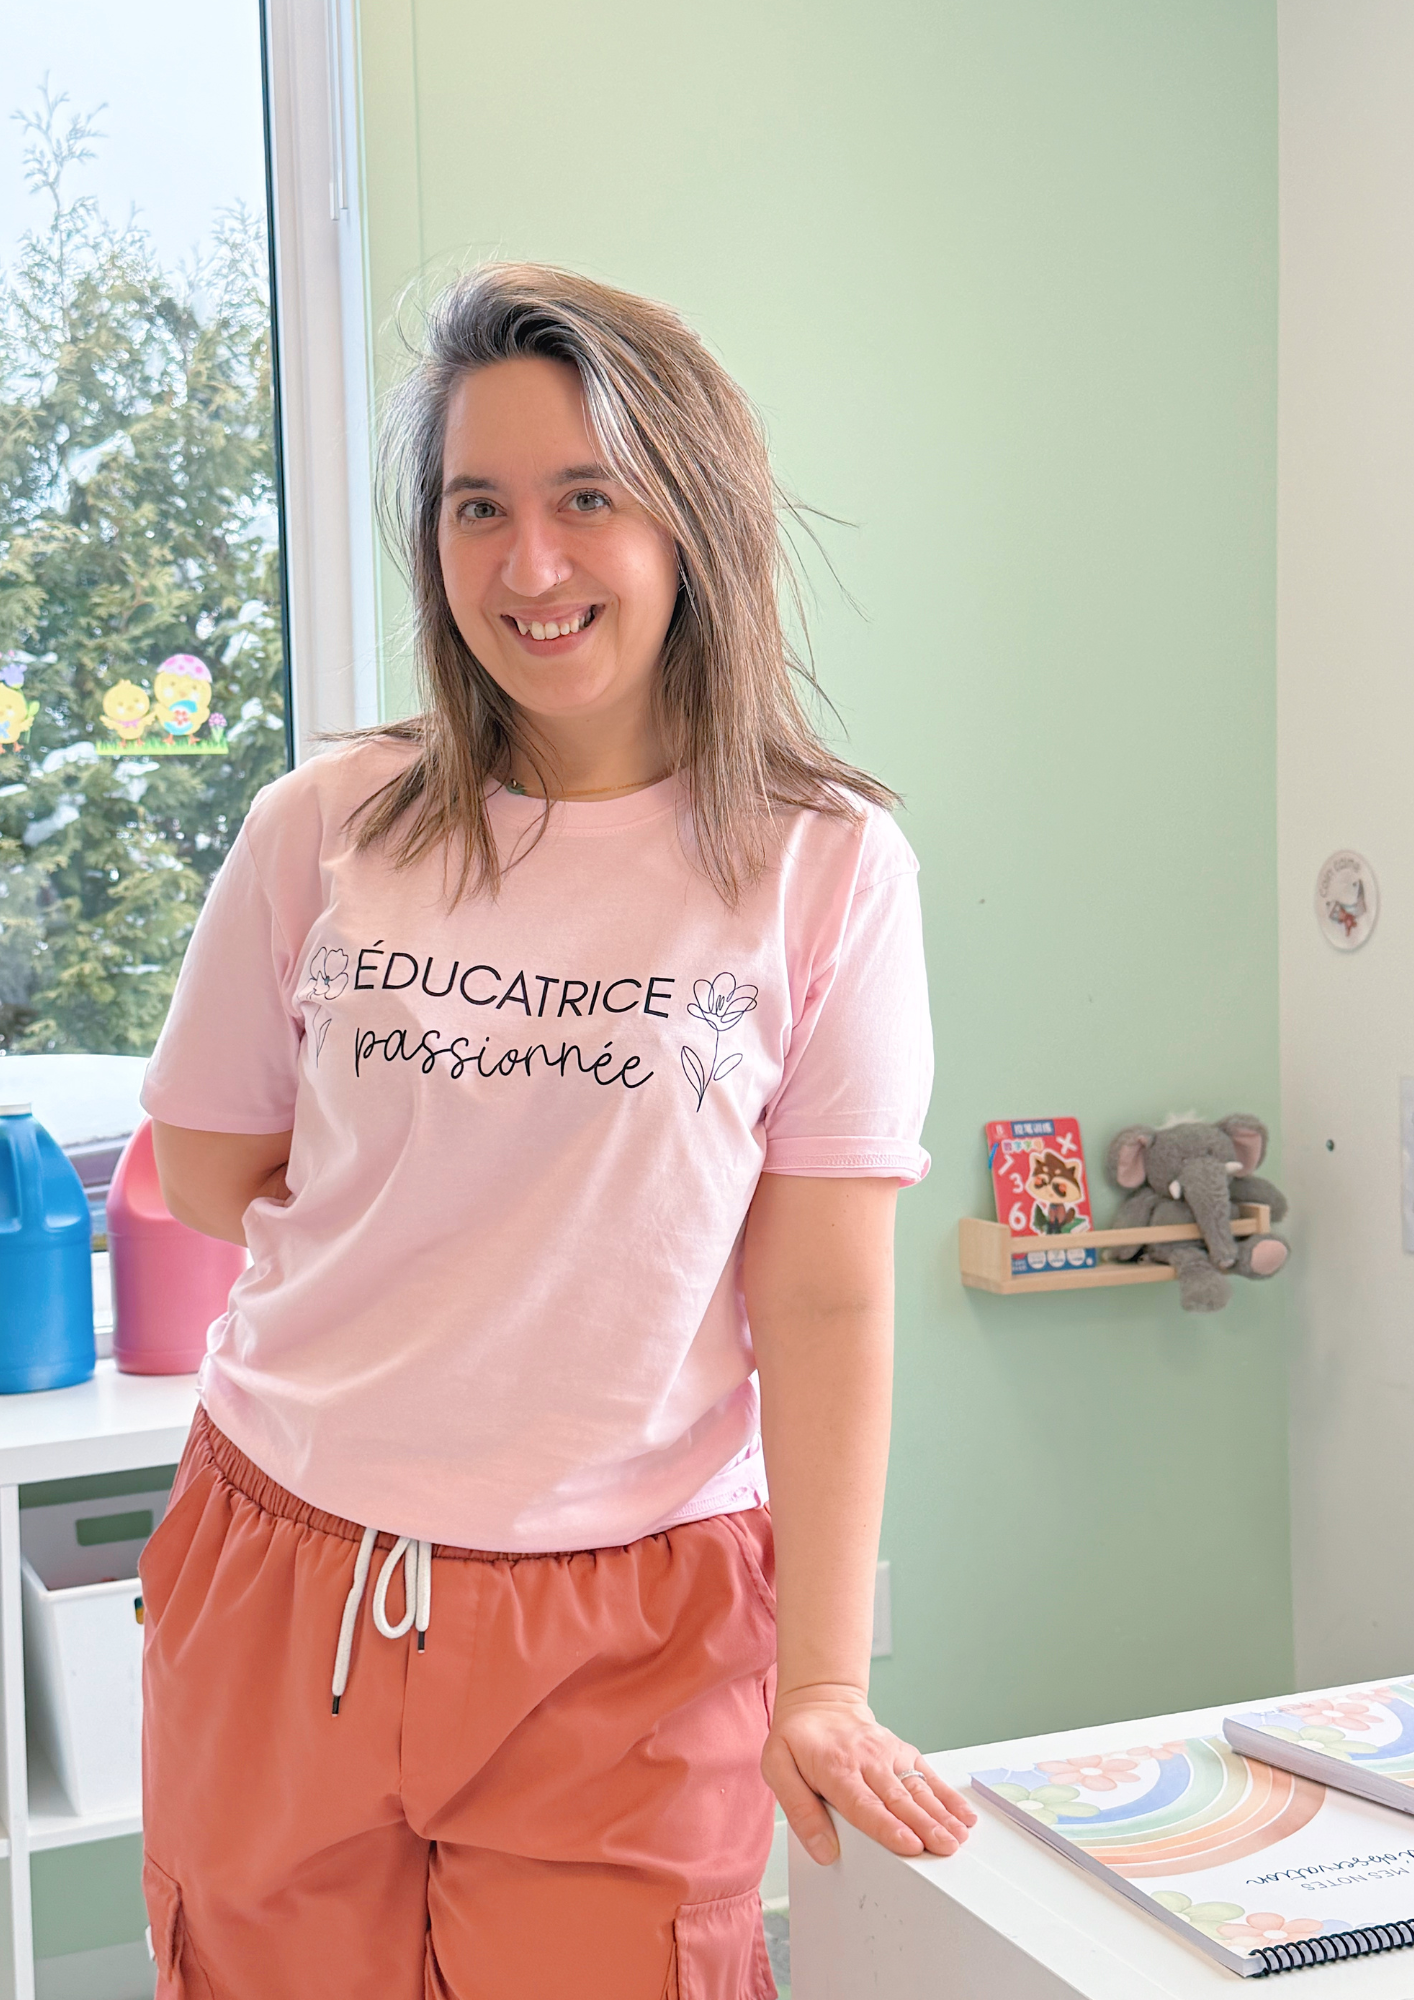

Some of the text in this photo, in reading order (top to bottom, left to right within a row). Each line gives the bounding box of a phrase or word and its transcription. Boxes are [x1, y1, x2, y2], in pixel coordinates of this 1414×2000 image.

[354, 940, 675, 1018] ÉDUCATRICE
[355, 1027, 654, 1088] passionnée
[1009, 1173, 1024, 1193] 3
[1009, 1202, 1027, 1231] 6
[1301, 1867, 1410, 1891] MES NOTES
